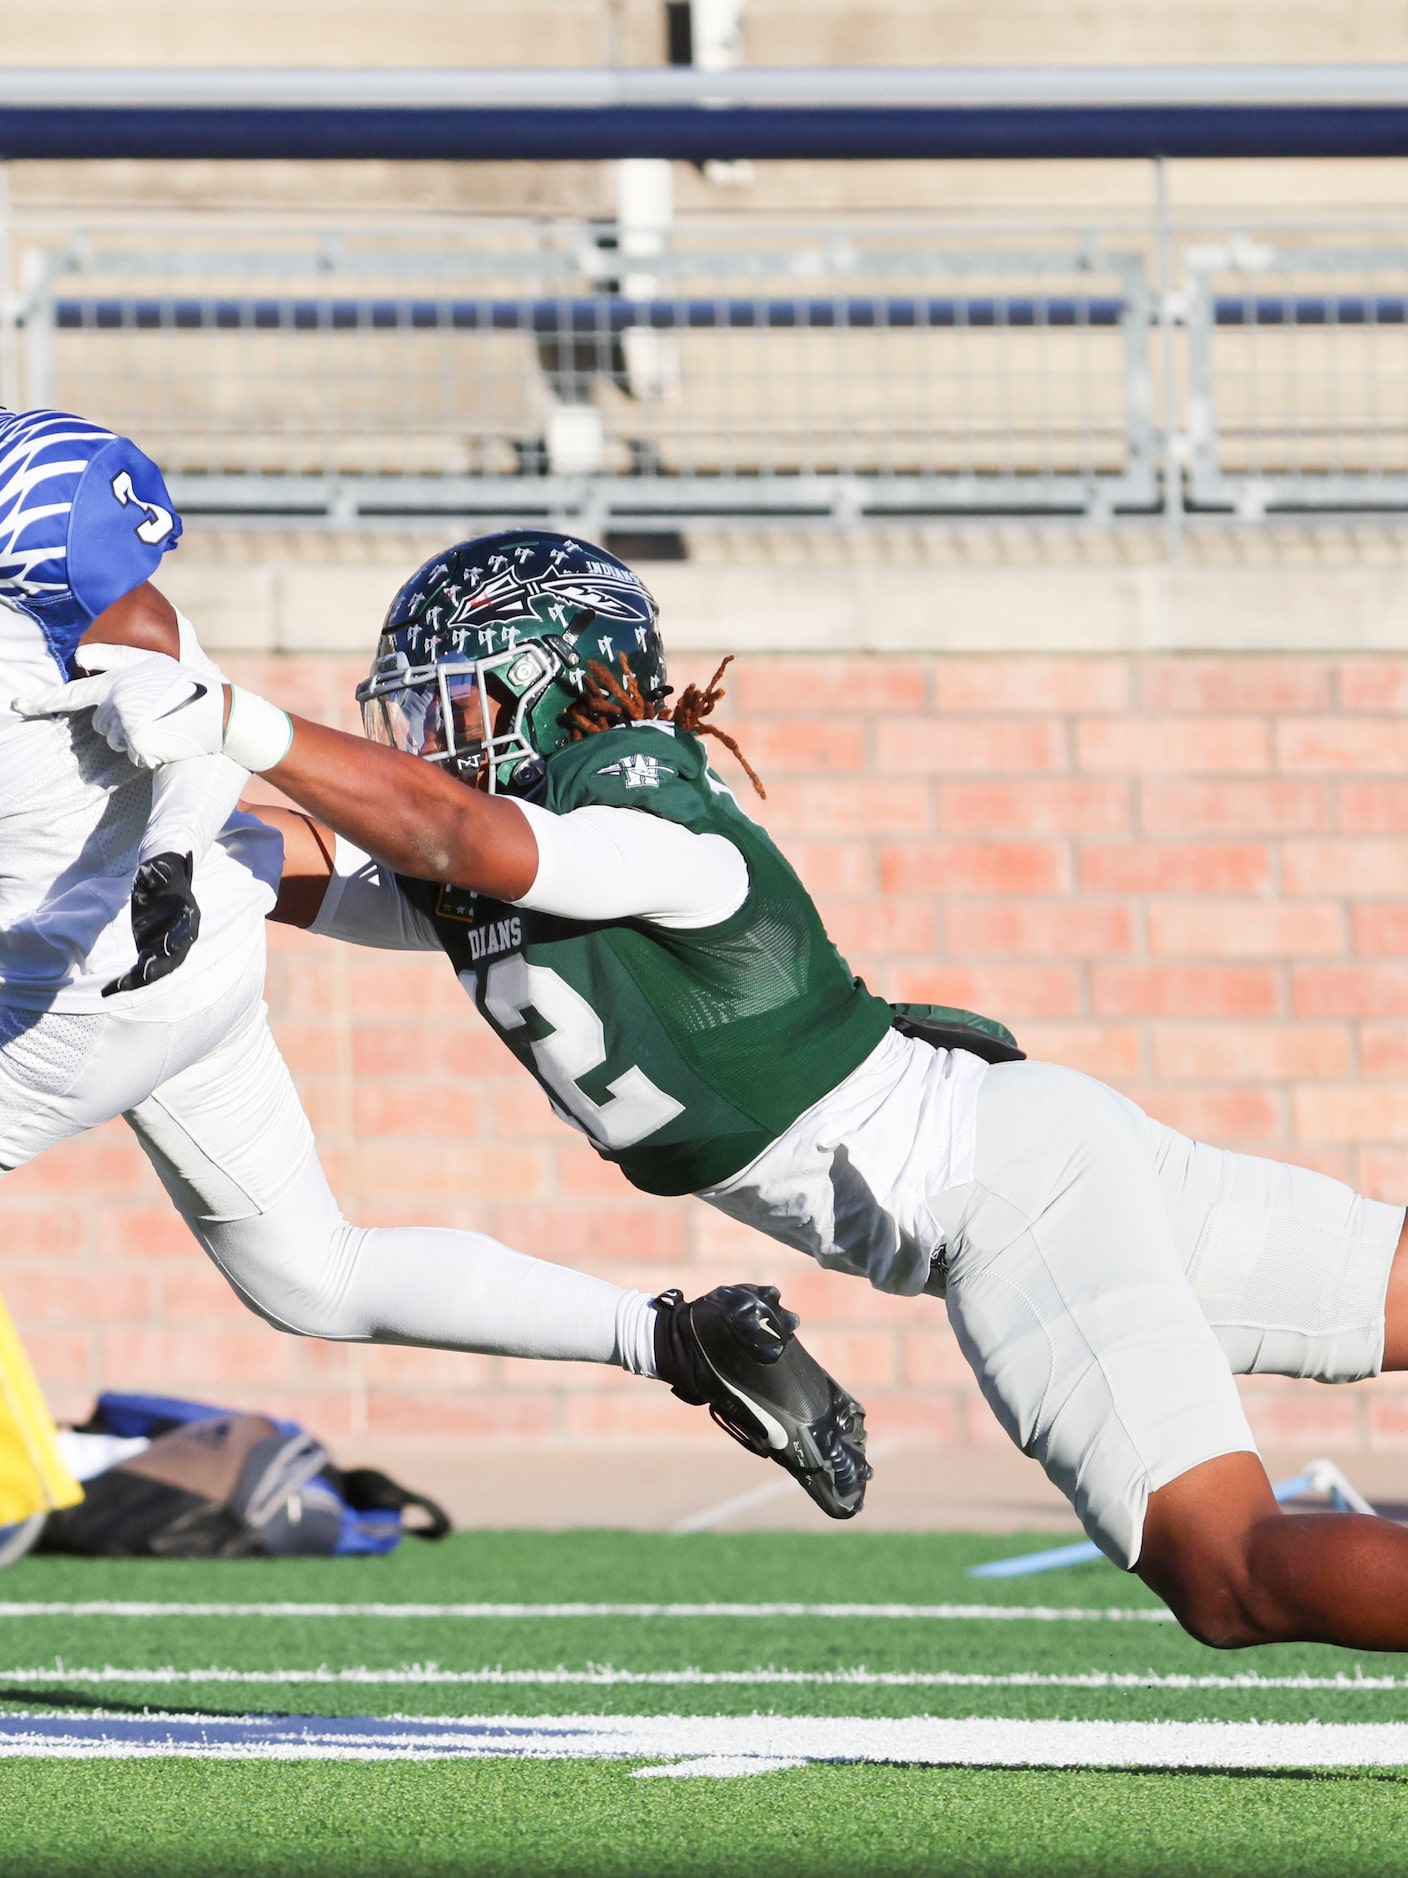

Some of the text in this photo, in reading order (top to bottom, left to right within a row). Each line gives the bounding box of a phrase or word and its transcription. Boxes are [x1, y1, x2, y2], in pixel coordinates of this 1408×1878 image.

[110, 468, 175, 546] 3
[585, 560, 640, 583] INDIANS
[467, 916, 522, 961] DIANS
[459, 952, 687, 1151] 2
